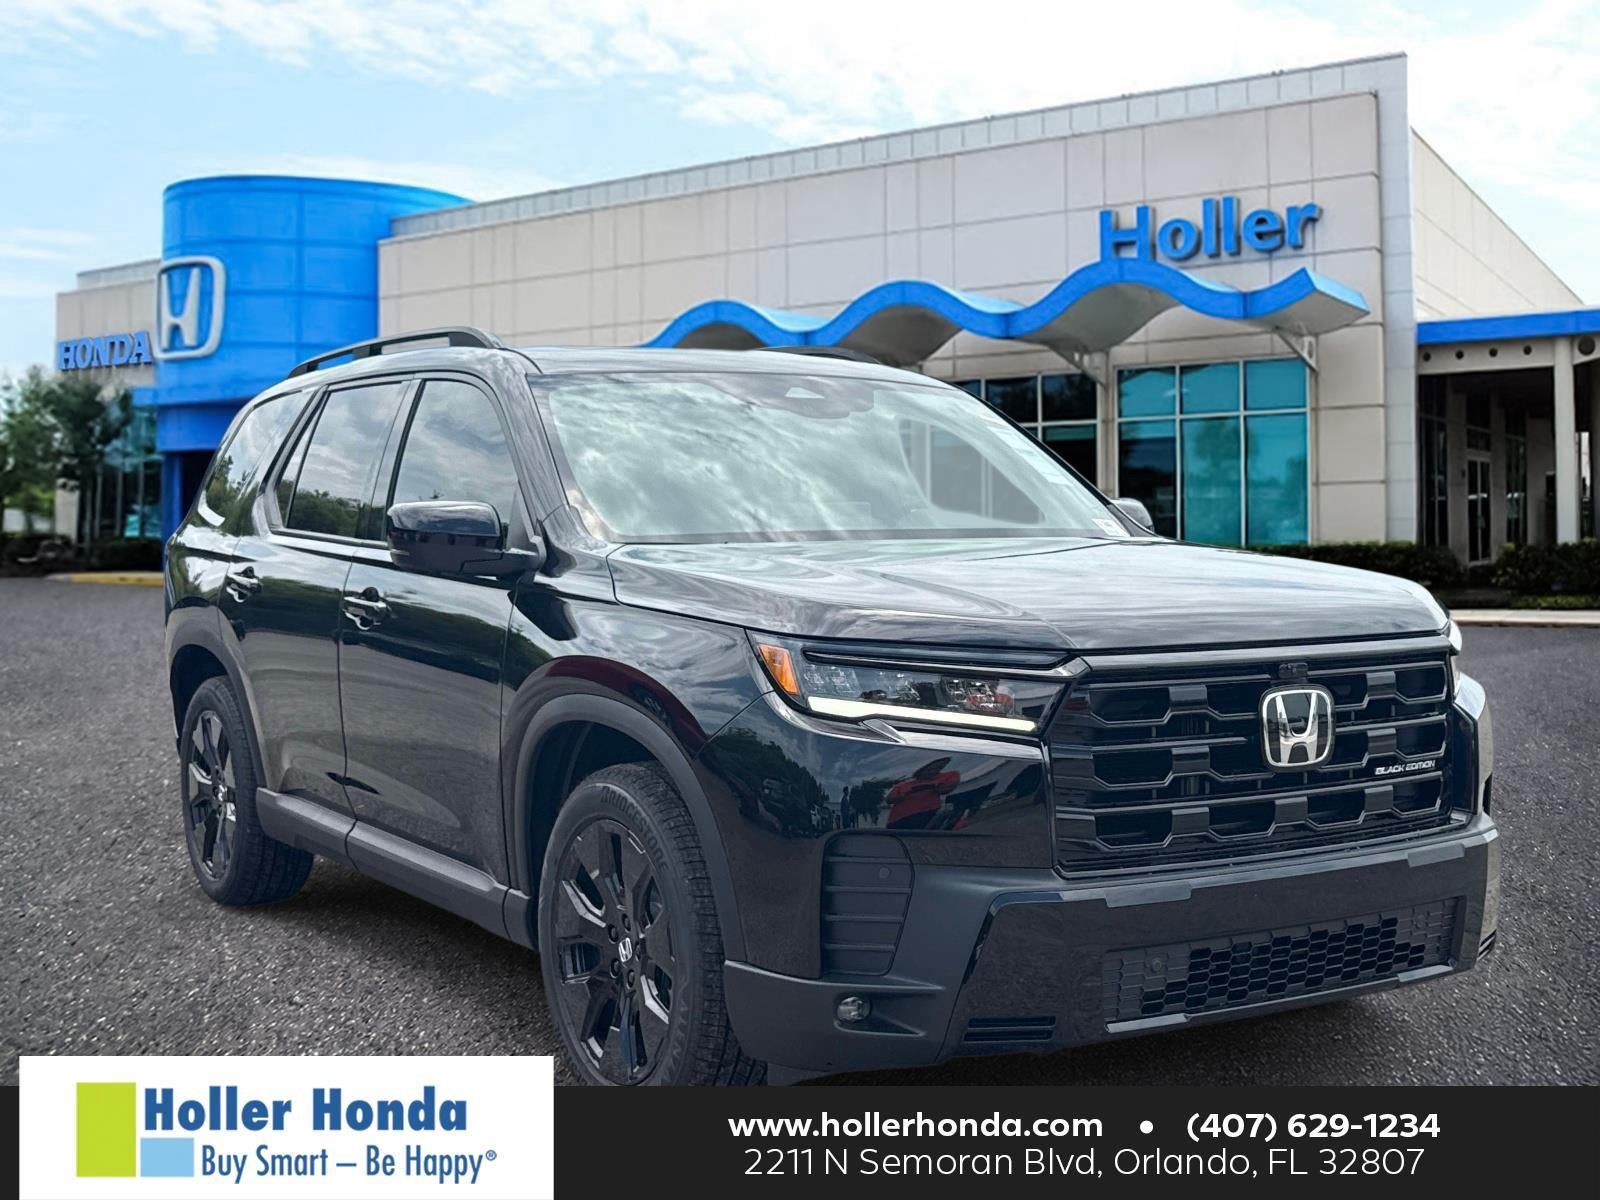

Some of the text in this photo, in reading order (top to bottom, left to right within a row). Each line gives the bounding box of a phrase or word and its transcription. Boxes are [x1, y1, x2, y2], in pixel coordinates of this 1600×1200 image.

[1099, 196, 1322, 261] Holler
[58, 330, 153, 372] HONDA
[1375, 759, 1436, 775] BLACK EDITION
